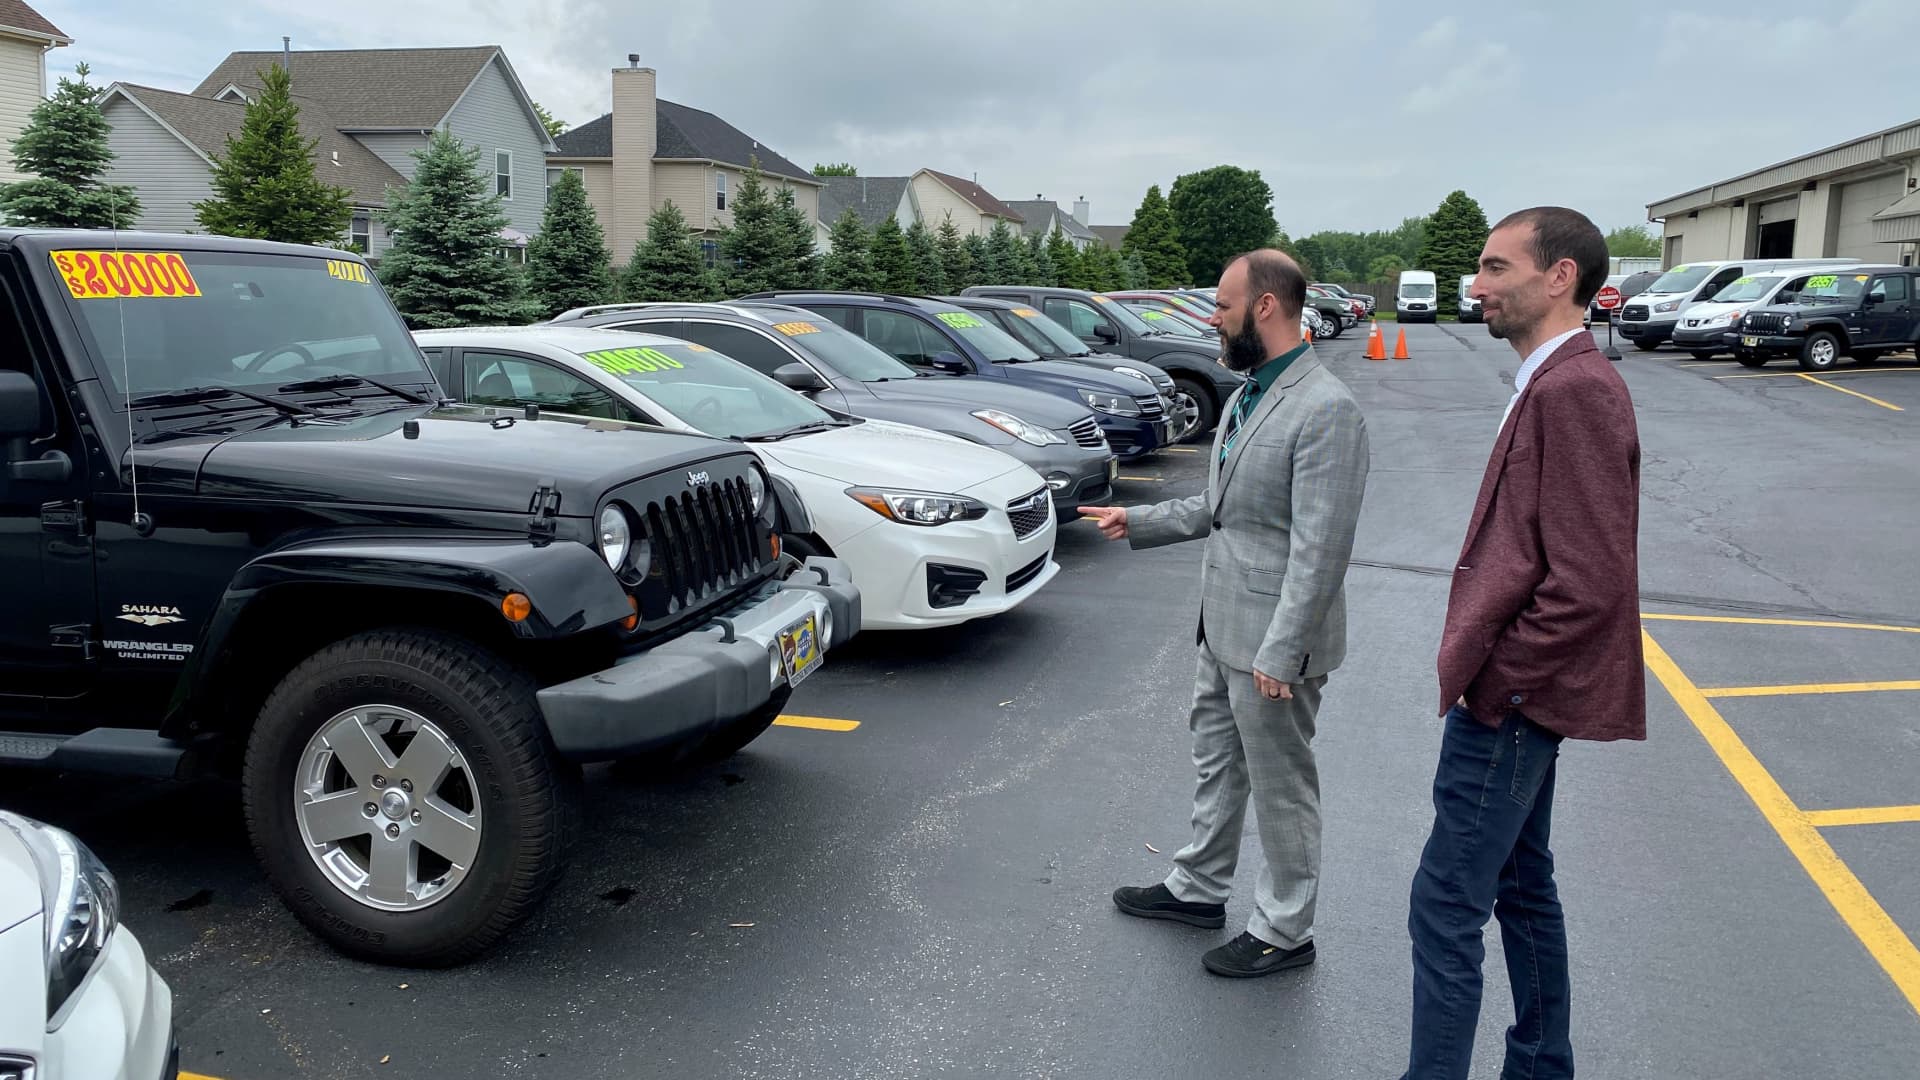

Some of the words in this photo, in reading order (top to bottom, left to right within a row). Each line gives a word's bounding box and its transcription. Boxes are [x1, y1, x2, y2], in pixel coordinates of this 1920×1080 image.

[687, 471, 710, 487] Jeep
[121, 604, 182, 614] SAHARA
[102, 640, 194, 653] WRANGLER
[118, 651, 185, 661] UNLIMITED
